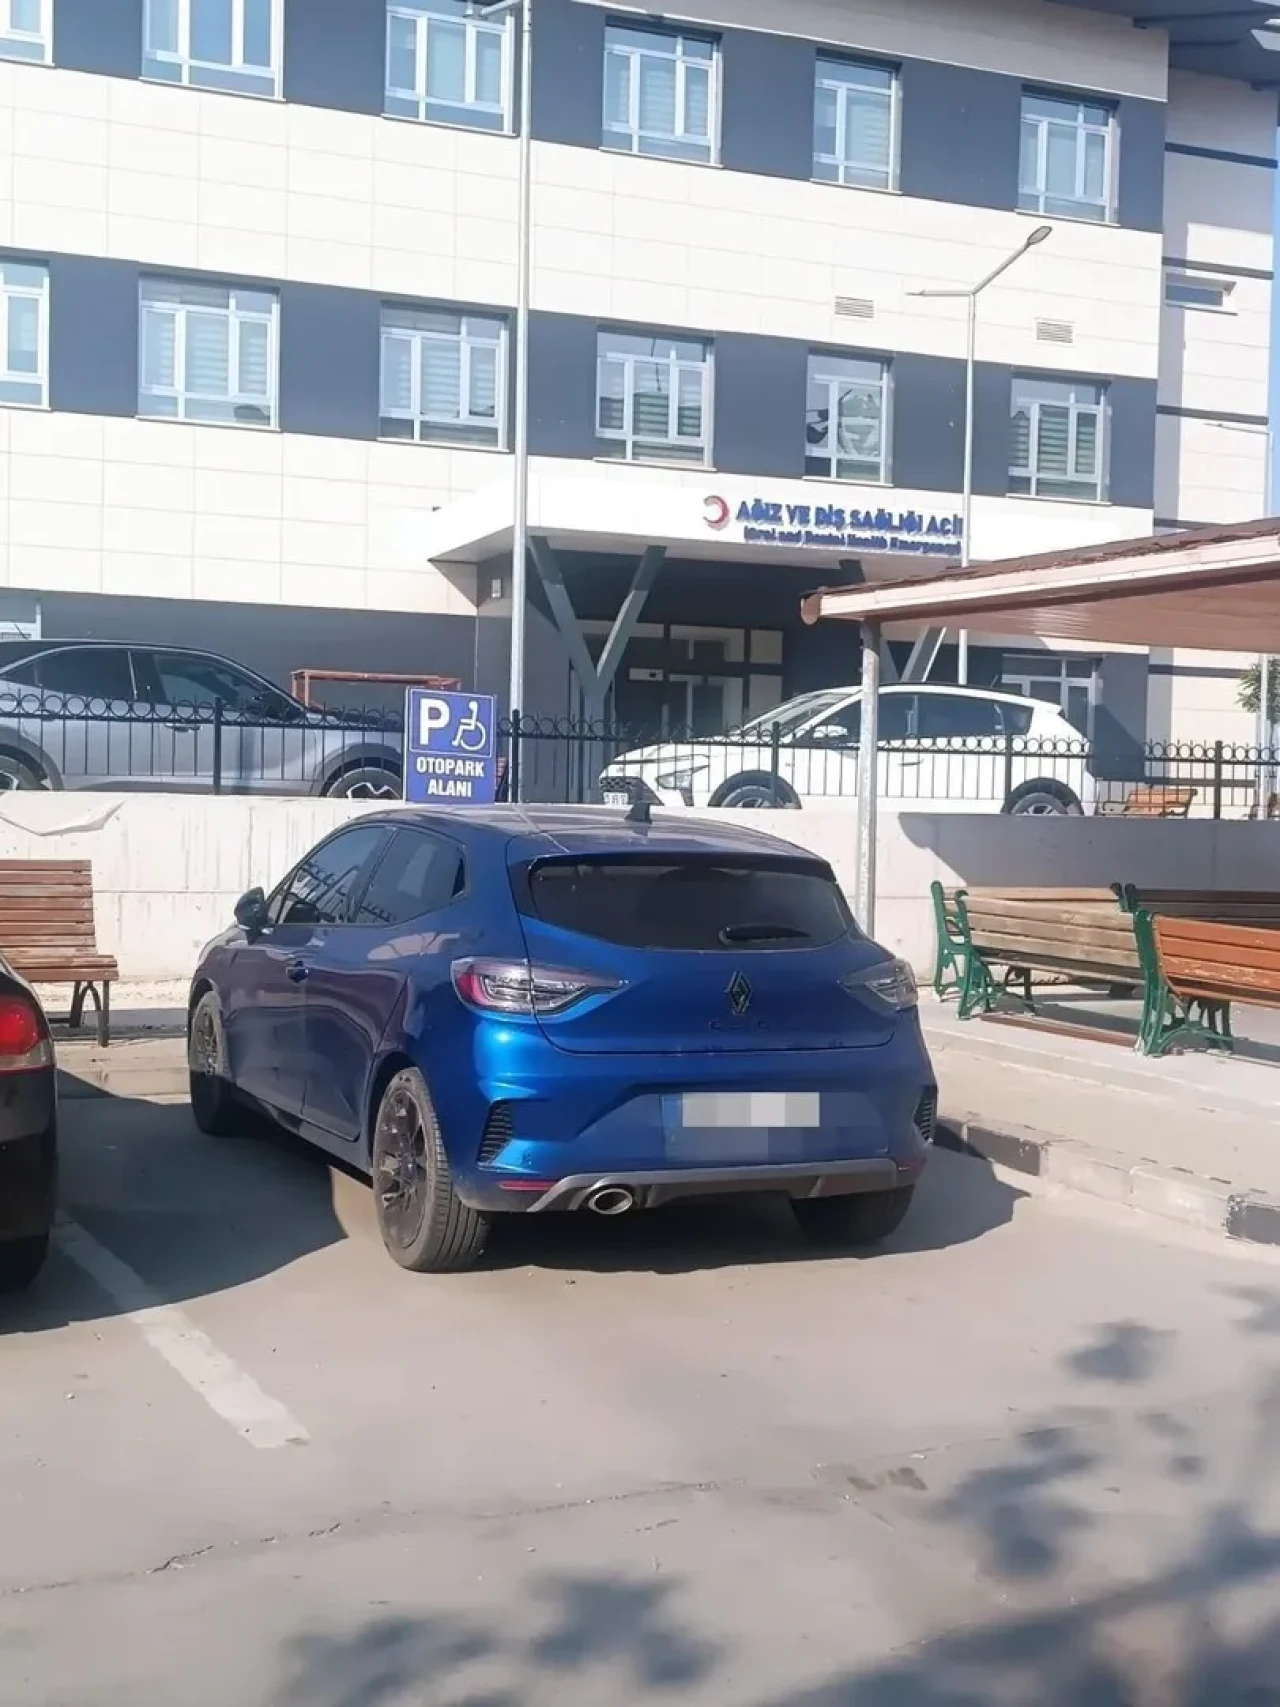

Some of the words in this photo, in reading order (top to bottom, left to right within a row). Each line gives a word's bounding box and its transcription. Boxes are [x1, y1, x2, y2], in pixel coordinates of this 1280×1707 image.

[736, 498, 783, 524] AĞIZ
[785, 504, 811, 526] VE
[815, 504, 845, 531] DİŞ
[850, 508, 923, 533] SAĞLIĞI
[420, 698, 450, 745] P
[416, 757, 485, 777] OTOPARK
[427, 779, 472, 798] ALANI
